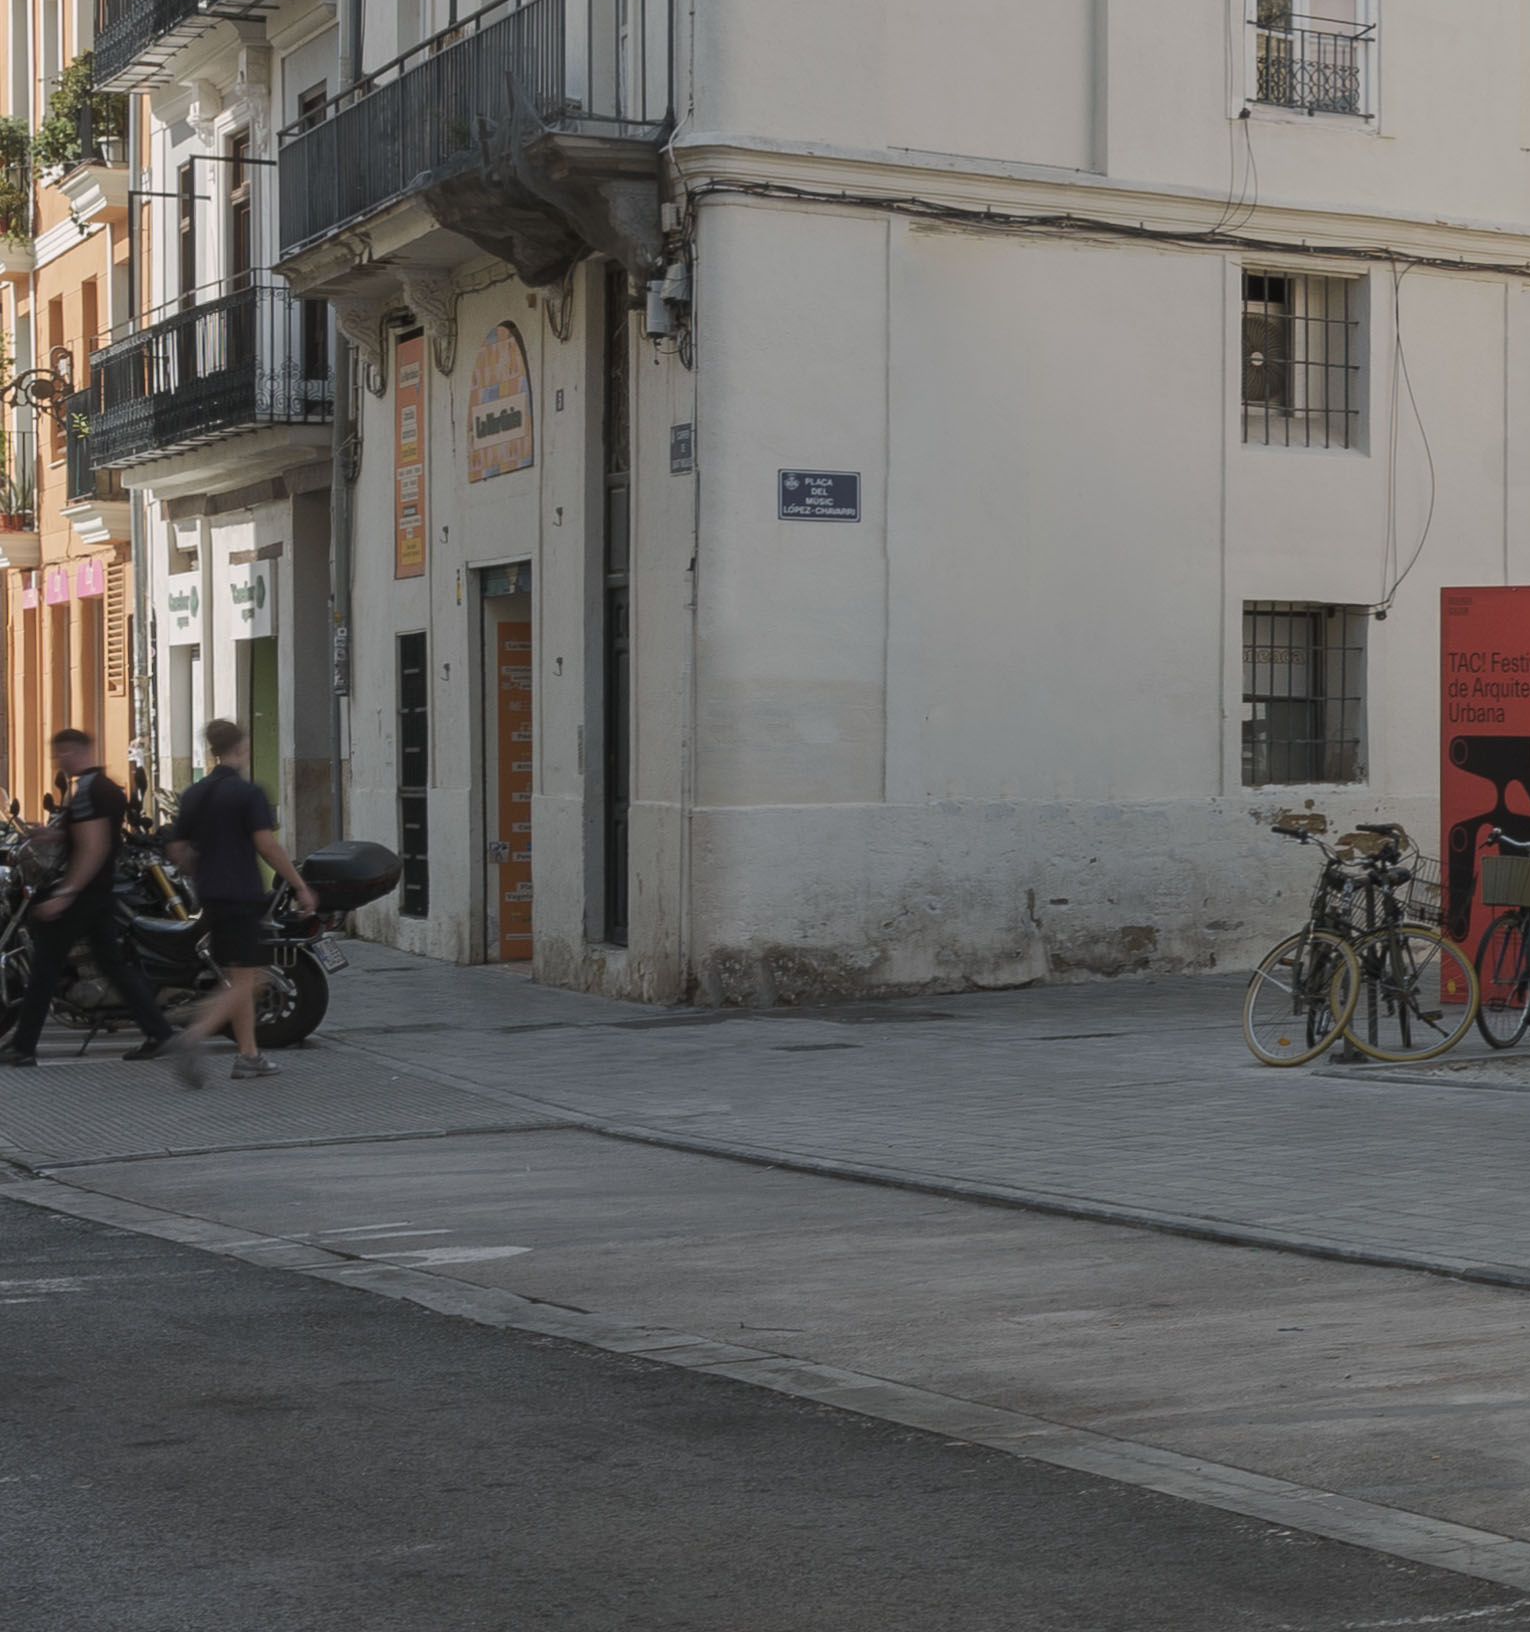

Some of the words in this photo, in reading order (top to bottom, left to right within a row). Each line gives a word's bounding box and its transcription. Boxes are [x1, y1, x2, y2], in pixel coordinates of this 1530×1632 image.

[810, 487, 828, 496] DEL
[1448, 652, 1486, 673] TAC!
[1448, 679, 1469, 698] de
[1448, 702, 1505, 723] Urbana
